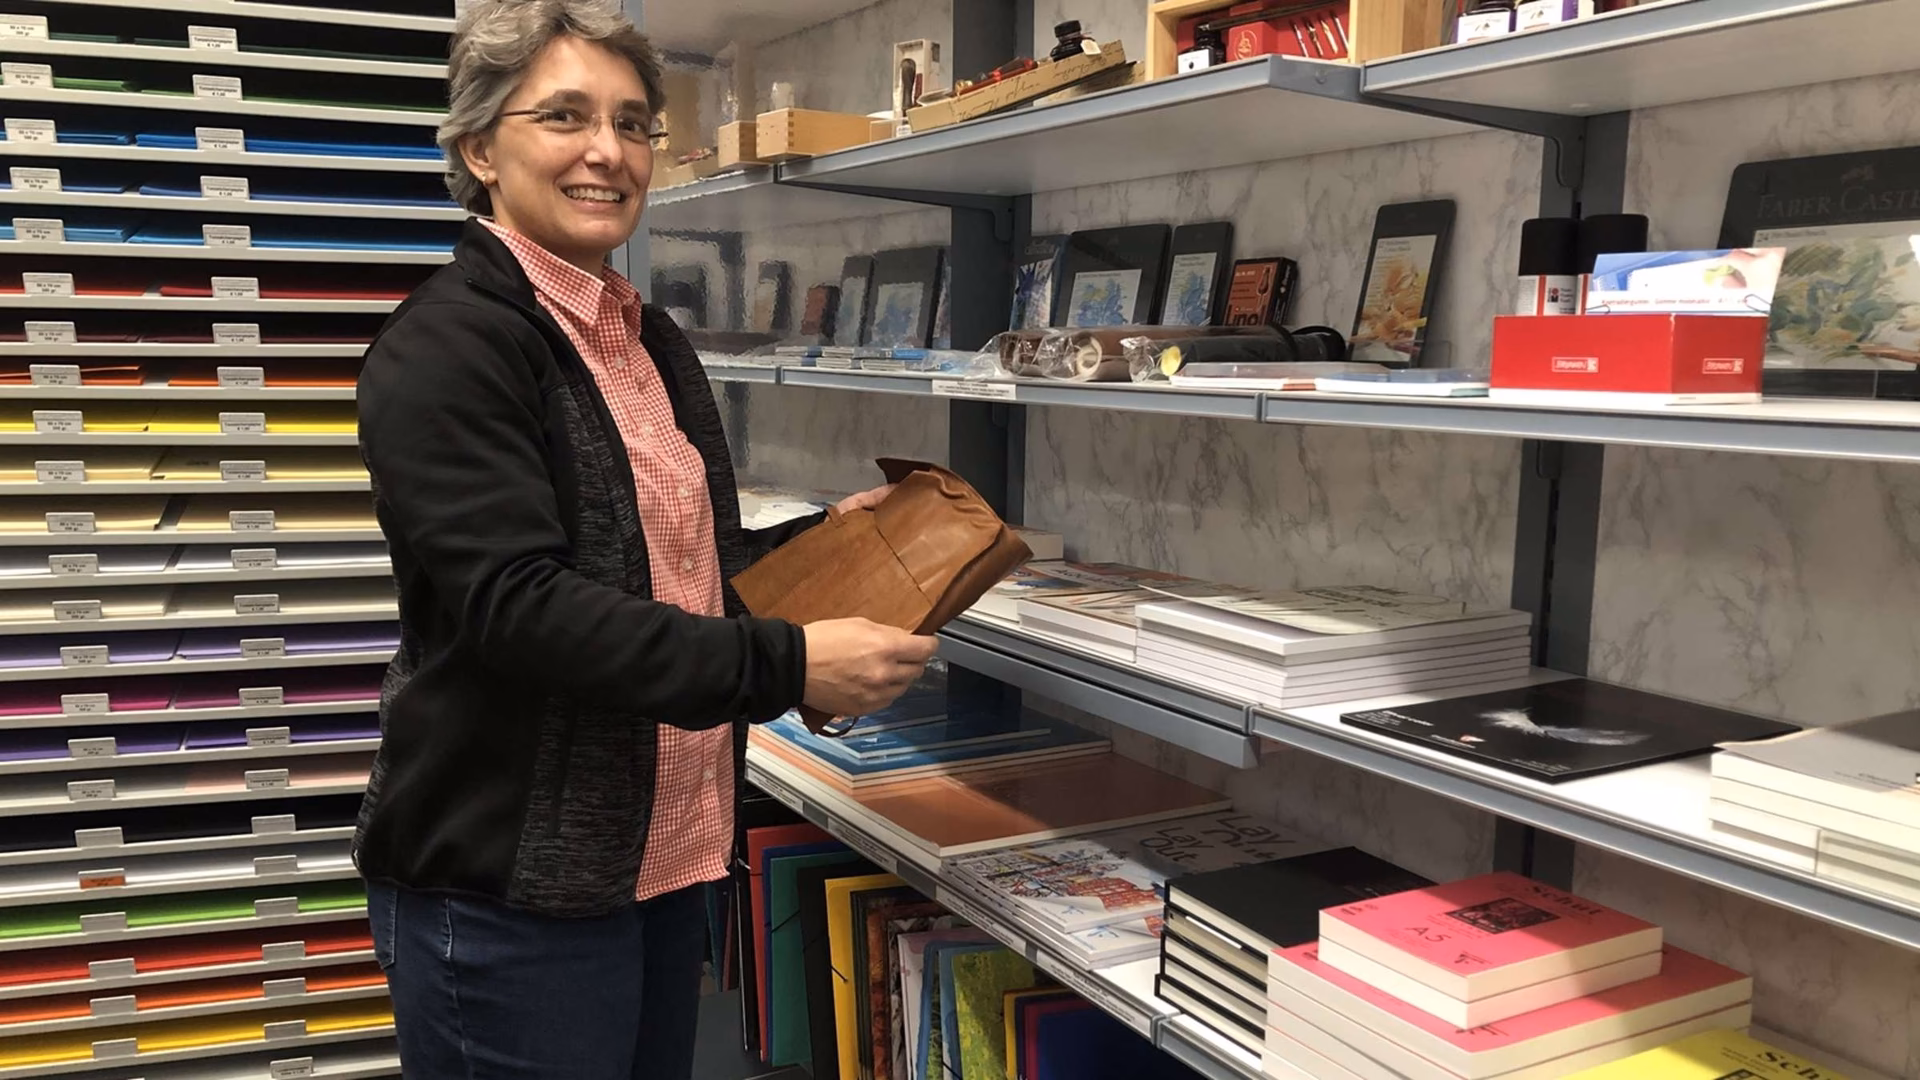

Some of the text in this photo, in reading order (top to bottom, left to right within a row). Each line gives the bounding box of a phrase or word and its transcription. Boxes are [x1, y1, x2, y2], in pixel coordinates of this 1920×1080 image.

[1156, 827, 1214, 848] Lay
[1217, 816, 1296, 843] Lay
[1140, 837, 1200, 862] Out
[1404, 926, 1452, 943] A5
